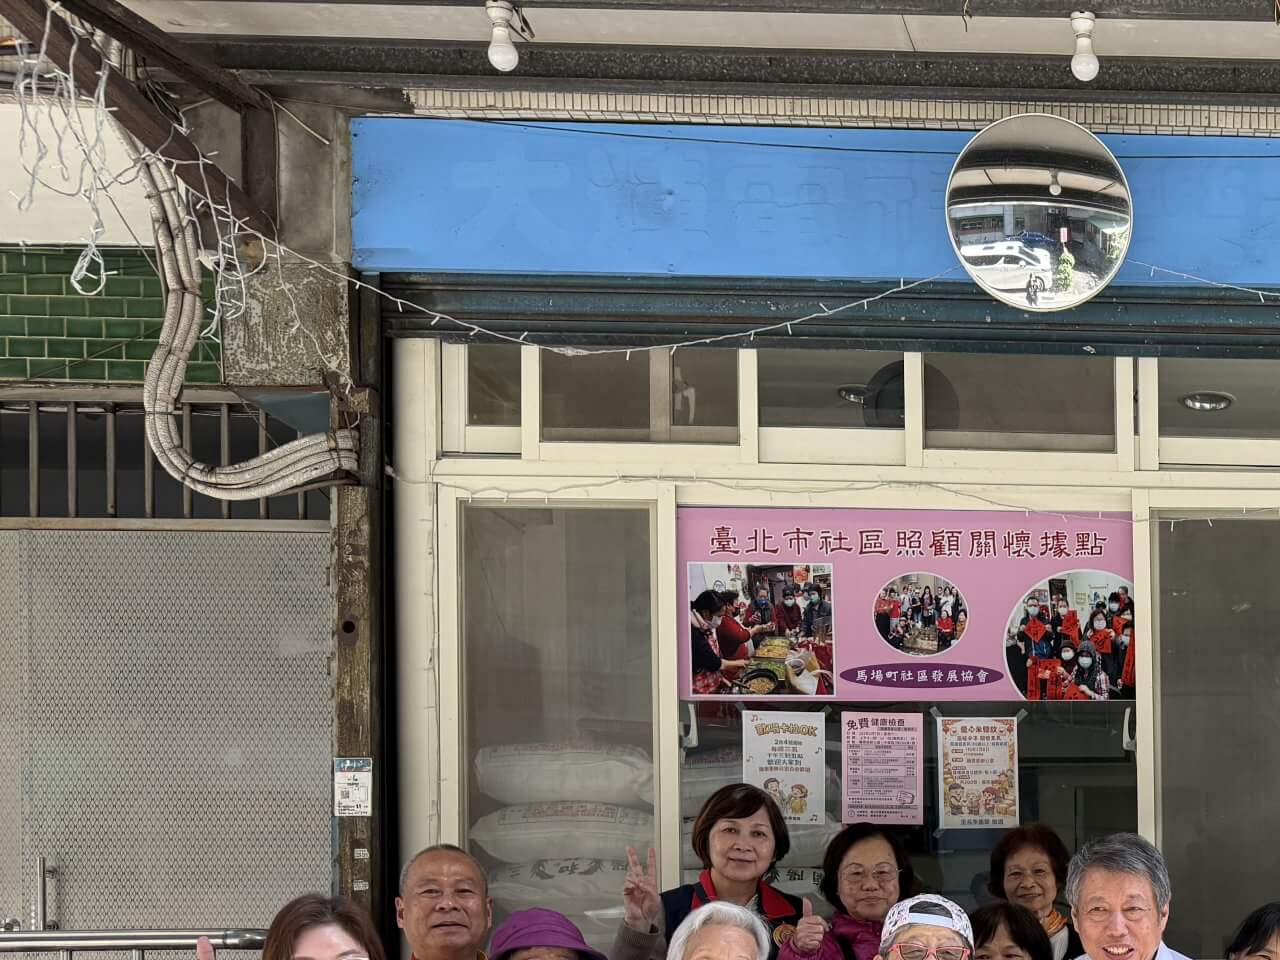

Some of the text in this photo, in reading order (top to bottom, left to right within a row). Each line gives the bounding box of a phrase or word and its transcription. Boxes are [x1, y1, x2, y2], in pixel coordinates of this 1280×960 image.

[710, 526, 1107, 558] 臺北市社區照顧關懷據點
[855, 669, 989, 683] 馬場町社區發展協會
[846, 717, 905, 731] 免費健康檢查
